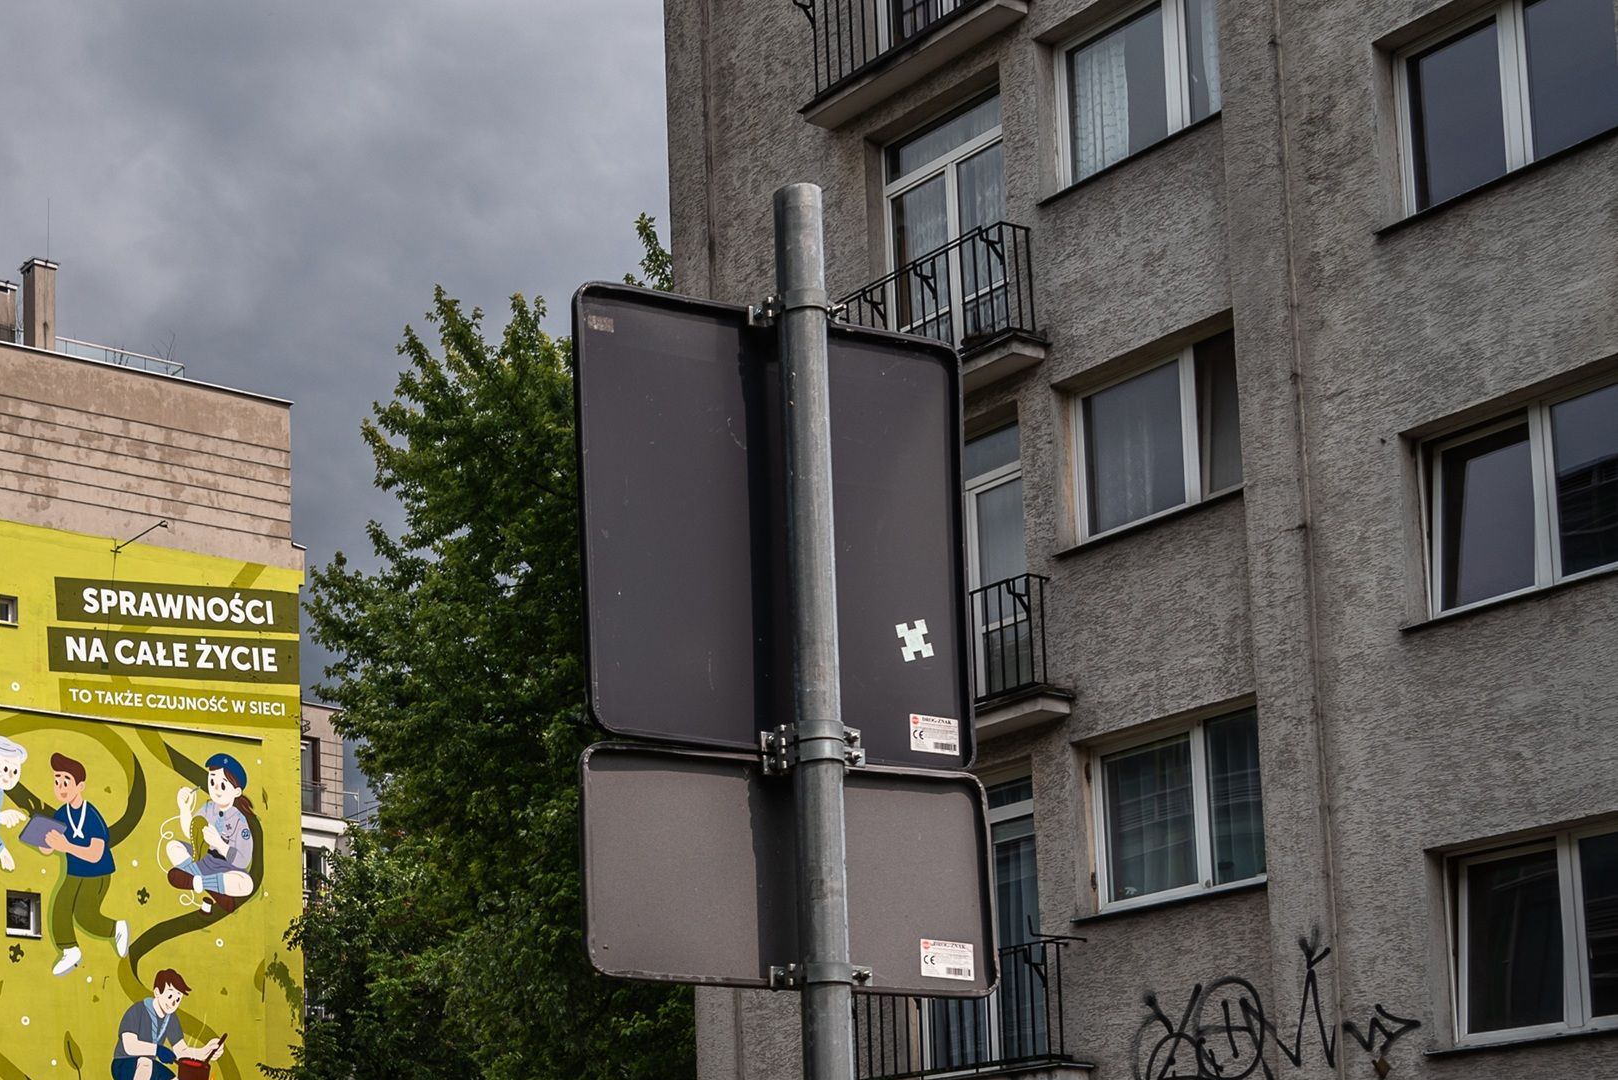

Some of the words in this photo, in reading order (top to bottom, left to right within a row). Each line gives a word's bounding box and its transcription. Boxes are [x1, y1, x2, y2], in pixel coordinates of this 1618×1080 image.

[82, 587, 275, 625] SPRAWNOŚCI
[65, 636, 109, 664] NA
[114, 639, 189, 668] CAŁE
[195, 638, 278, 672] ŻYCIE
[69, 688, 93, 704] TO
[94, 689, 143, 707] TAKŻE
[146, 693, 229, 713] CZUJNOŚĆ
[231, 700, 247, 714] W
[249, 701, 286, 717] SIECI
